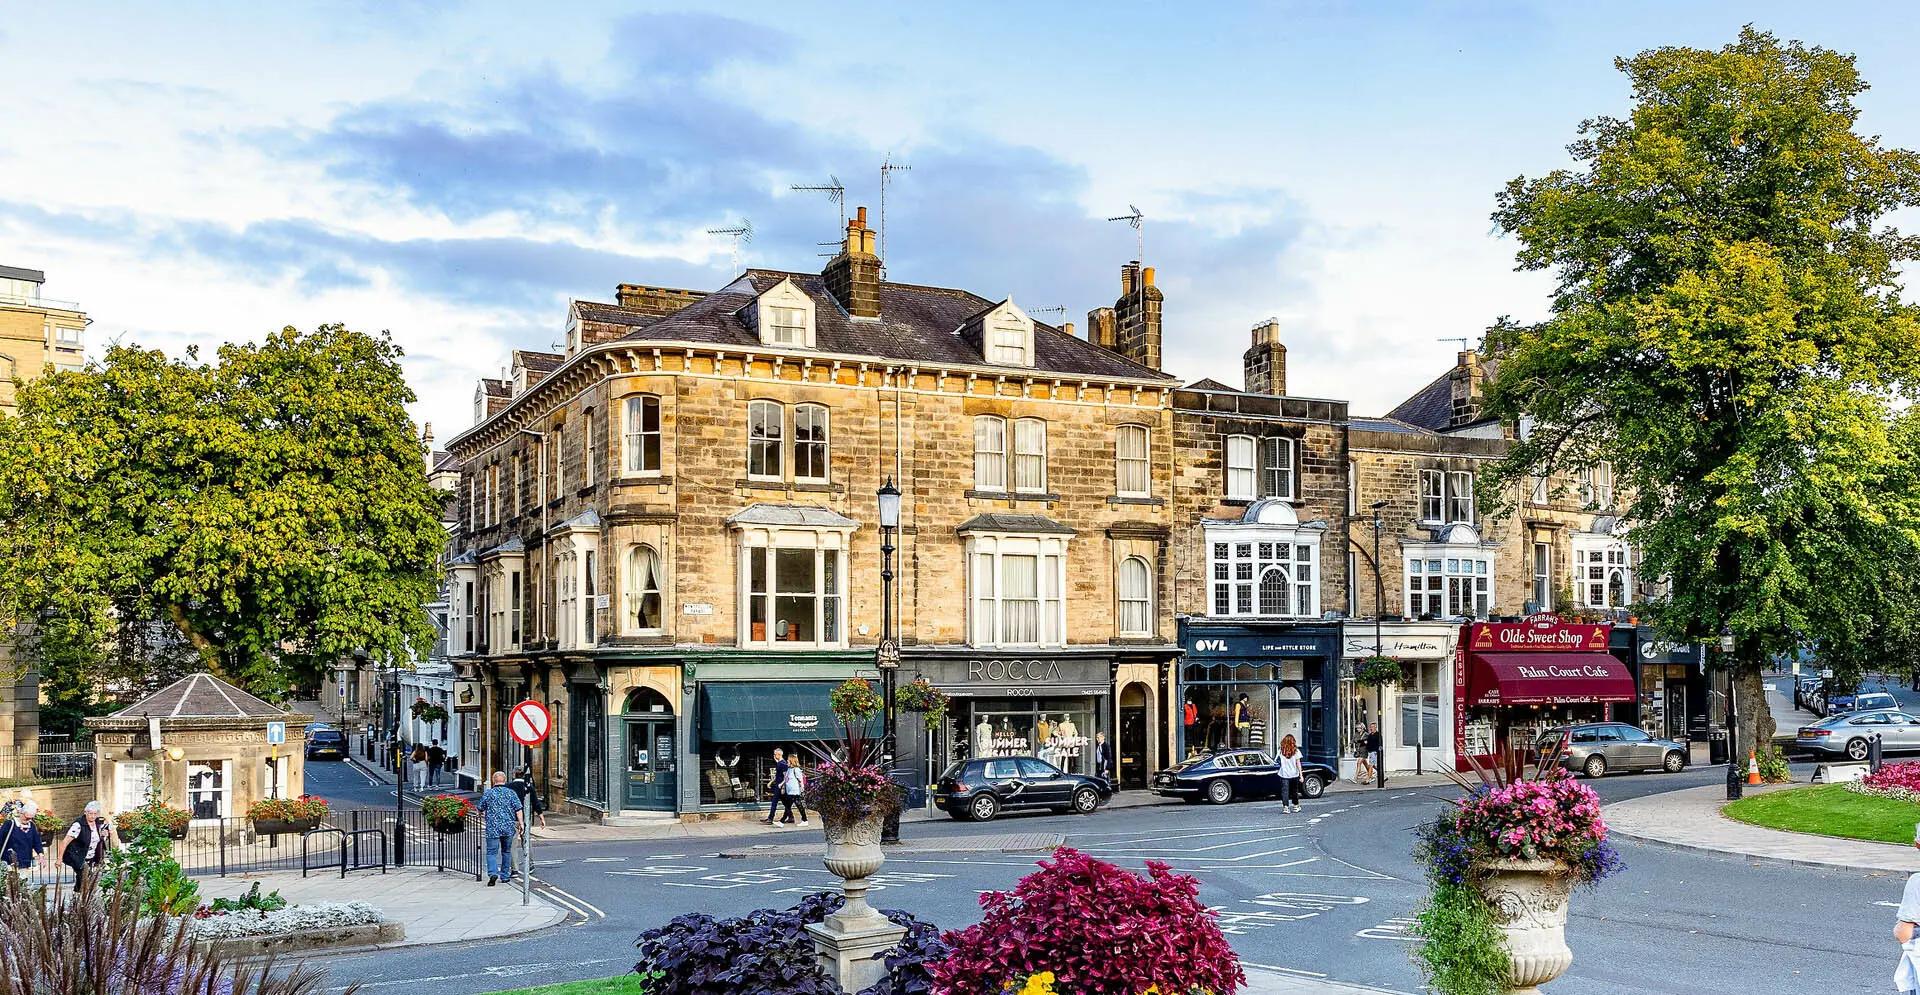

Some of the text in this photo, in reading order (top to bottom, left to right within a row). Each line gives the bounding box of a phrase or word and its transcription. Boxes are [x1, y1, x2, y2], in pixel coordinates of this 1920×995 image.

[1500, 628, 1582, 648] Olde Sweet Shop
[1195, 640, 1228, 651] OWL
[968, 660, 1062, 680] ROCCA
[1518, 665, 1609, 678] Palm Court Cafe
[1045, 736, 1088, 748] SUMMER
[1054, 747, 1080, 757] SALE
[604, 865, 708, 876] NO
